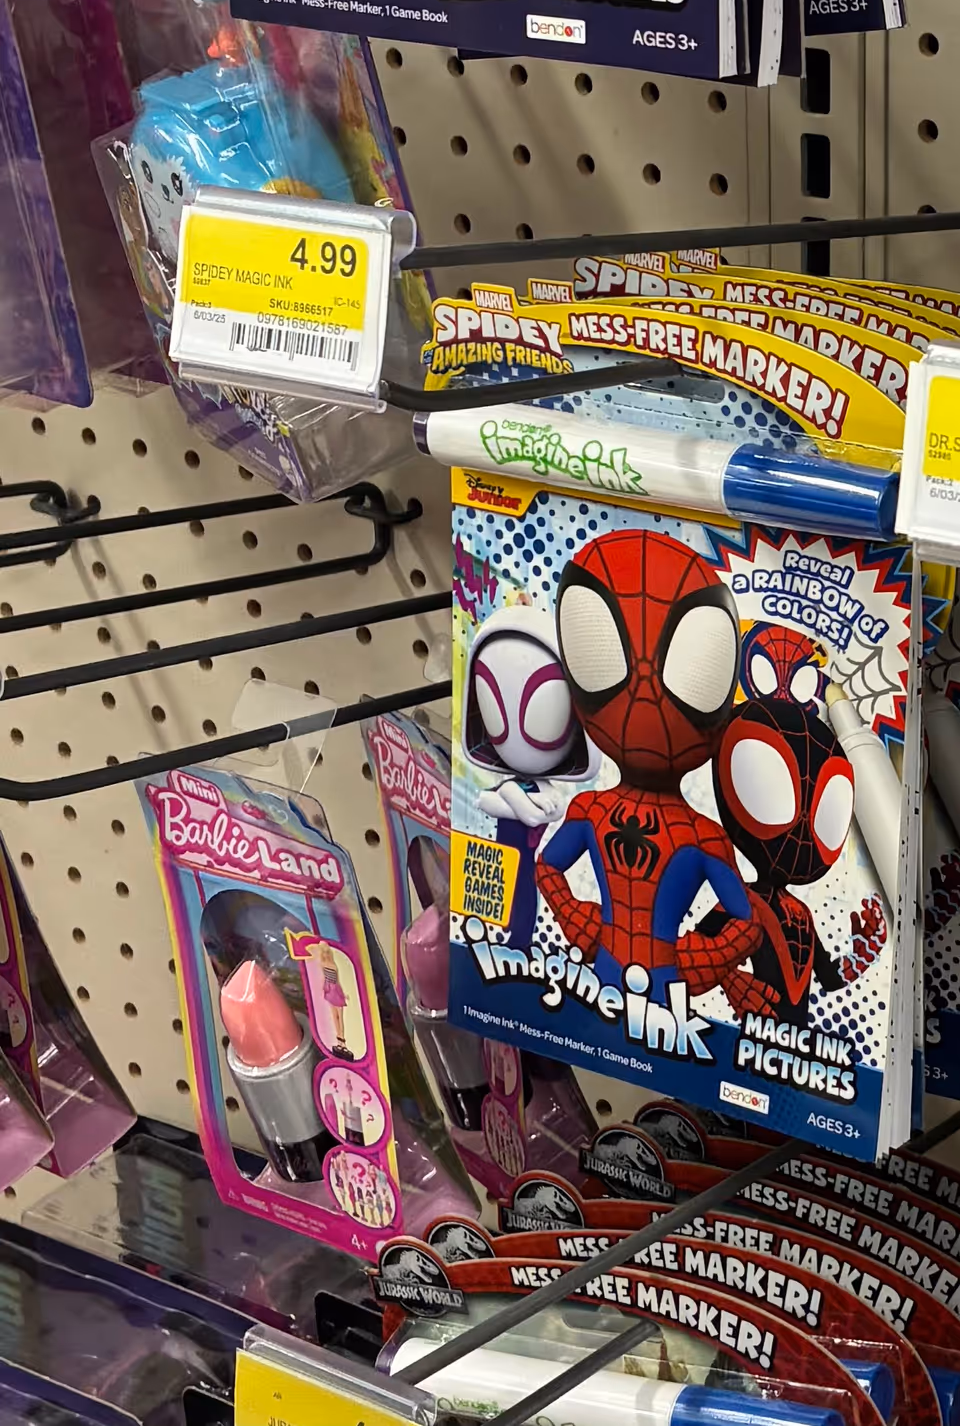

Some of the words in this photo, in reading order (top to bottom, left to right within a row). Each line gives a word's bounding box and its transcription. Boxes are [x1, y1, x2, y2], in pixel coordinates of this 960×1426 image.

[350, 1, 384, 16] Marker,
[391, 6, 421, 20] Game
[422, 10, 448, 23] Book
[530, 20, 583, 39] bendon
[632, 29, 676, 49] AGES
[677, 33, 698, 50] 3+
[290, 237, 357, 277] 4.99
[624, 254, 665, 272] MARVEL
[193, 262, 233, 282] SPIDEY
[235, 270, 272, 287] MAGIC
[273, 275, 293, 290] INK
[475, 290, 512, 312] MARVEL
[532, 282, 573, 303] MARVEL
[269, 298, 334, 317] SKU:8966517
[257, 311, 348, 336] 0978169021587
[434, 305, 562, 355] SPIDEY
[432, 342, 503, 371] AMAZING
[505, 343, 574, 373] FRIENDS
[568, 314, 698, 361] MESS-FREE
[701, 332, 848, 433] MARKER!
[784, 551, 854, 585] Reveal
[753, 570, 864, 621] RAINBOW
[762, 596, 850, 648] COLORS!
[182, 777, 218, 801] Mini
[467, 840, 503, 865] MAGIC
[464, 858, 505, 884] REVEAL
[465, 876, 504, 902] GAMES
[464, 894, 504, 921] INSIDE!
[465, 918, 623, 1018] imagine
[624, 966, 712, 1060] ink
[467, 1008, 500, 1024] Imagine
[519, 1023, 563, 1045] Mess-Free
[565, 1037, 596, 1056] Marker,
[602, 1047, 629, 1066] Game
[630, 1057, 653, 1073] Book
[744, 1013, 811, 1053] MAGIC
[814, 1033, 852, 1067] INK
[737, 1040, 855, 1101] PICTURES
[722, 1085, 767, 1110] bendon
[807, 1112, 843, 1133] AGES
[843, 1123, 861, 1138] 3+
[584, 1153, 628, 1180] JURASSIC
[629, 1174, 671, 1198] WORLD
[351, 1234, 367, 1250] 4+
[379, 1280, 420, 1300] JURASSIC
[420, 1286, 464, 1307] WORLD
[684, 1247, 821, 1327] MARKER!
[637, 1286, 774, 1369] MARKER!
